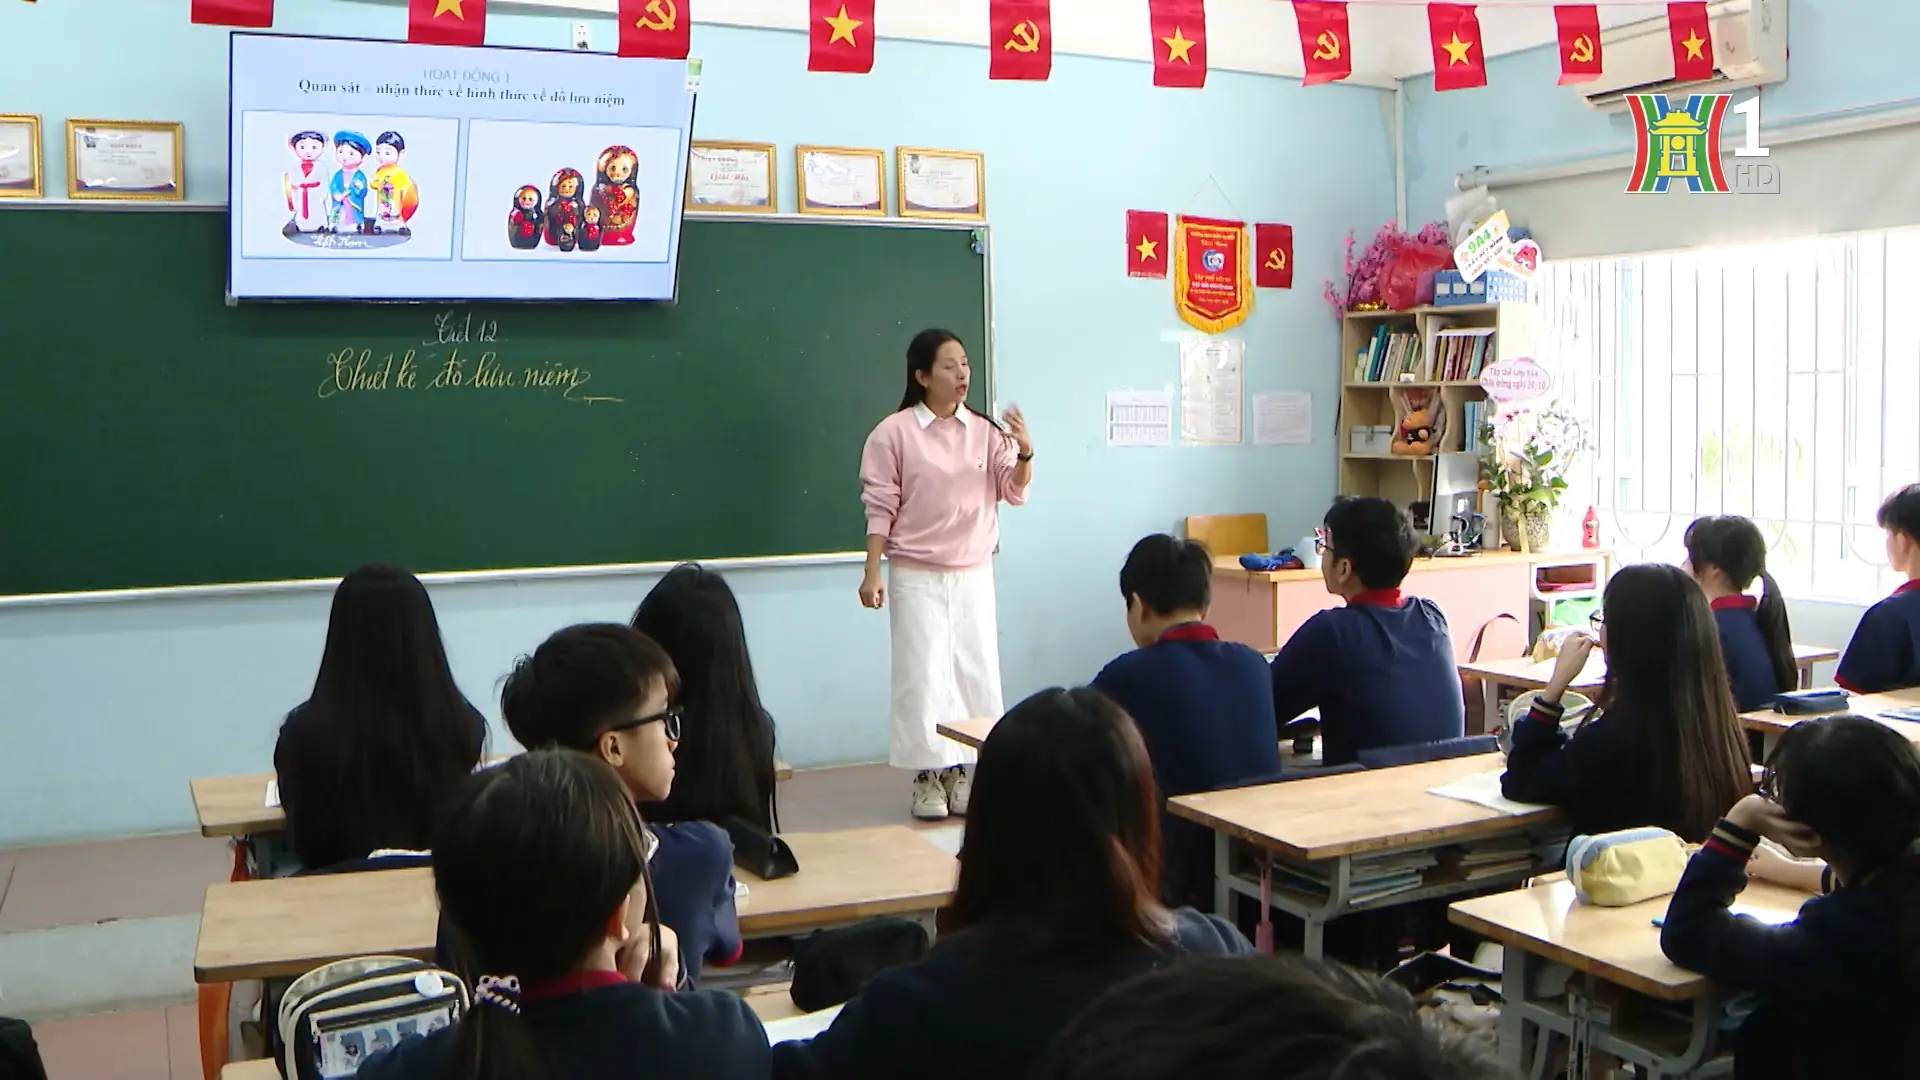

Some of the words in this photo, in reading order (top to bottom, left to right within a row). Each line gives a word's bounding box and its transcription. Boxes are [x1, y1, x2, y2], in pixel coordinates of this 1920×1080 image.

[299, 79, 337, 94] Quan
[341, 82, 360, 94] sát
[376, 83, 409, 97] nhận
[414, 84, 444, 97] thức
[449, 83, 462, 98] về
[467, 87, 495, 100] hình
[500, 89, 529, 102] thức
[532, 87, 546, 102] về
[550, 87, 566, 103] đồ
[570, 92, 590, 104] lưu
[595, 93, 625, 108] niệm
[1467, 229, 1492, 254] 9A4
[477, 319, 497, 342] 12
[318, 347, 394, 398] Thiết
